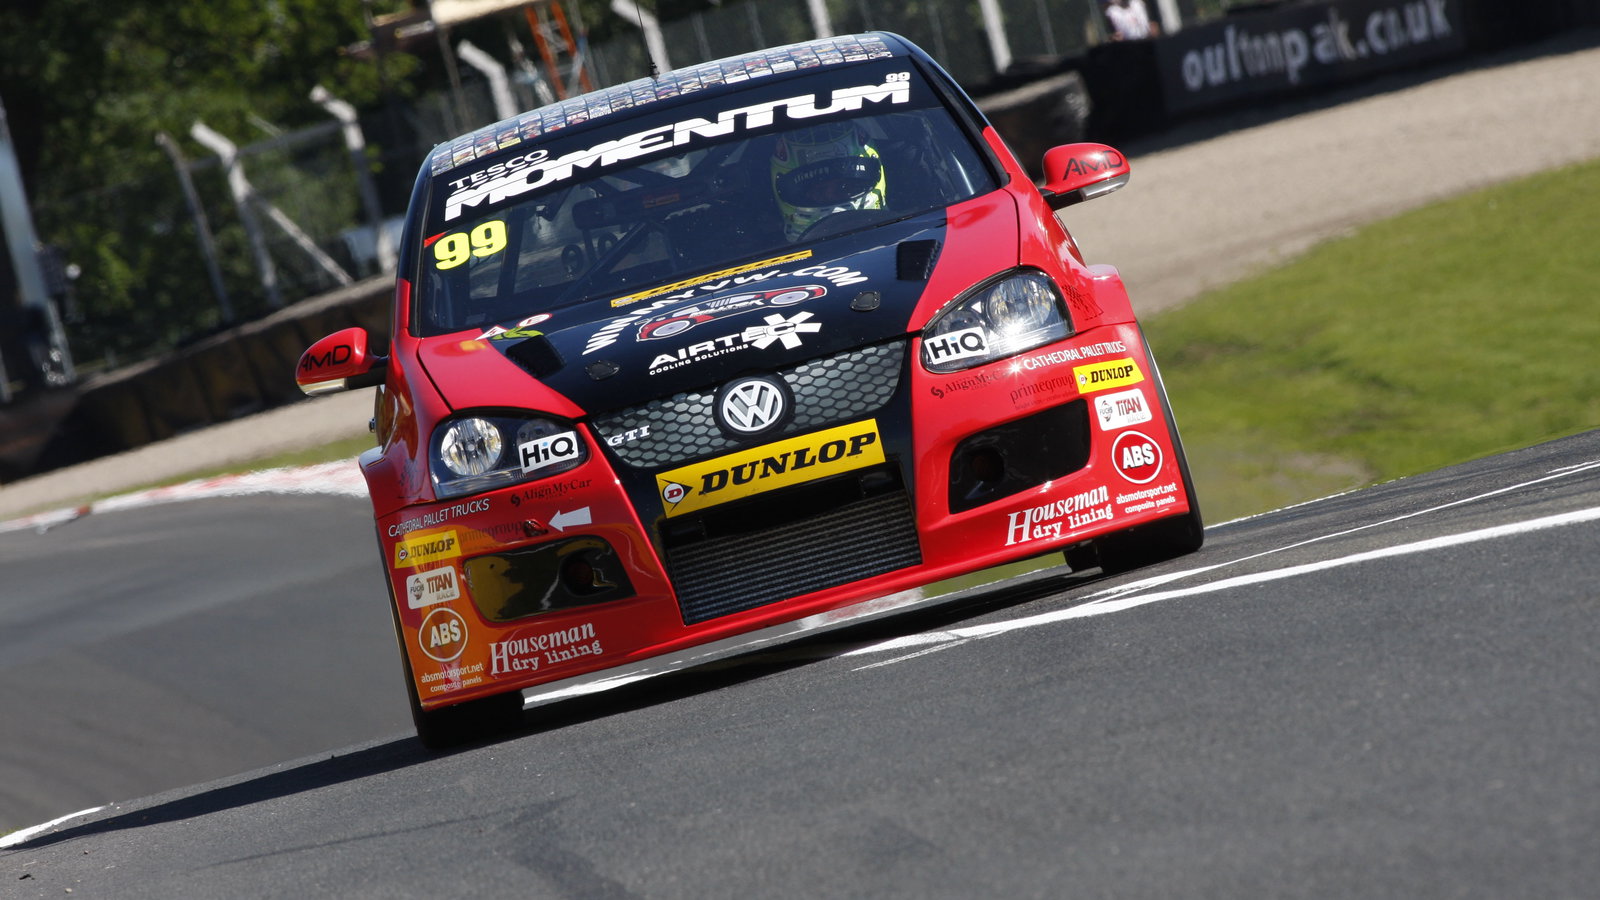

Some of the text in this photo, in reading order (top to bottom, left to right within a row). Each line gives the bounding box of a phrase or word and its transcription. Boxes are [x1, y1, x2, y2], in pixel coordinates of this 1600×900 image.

[886, 72, 910, 82] 99
[445, 81, 910, 221] MOMENTUM
[1063, 150, 1123, 181] AMD
[449, 150, 549, 189] TESCO
[434, 220, 507, 270] 99
[649, 322, 797, 370] AIRTEC
[650, 344, 749, 375] COOLING SOLUTIONS
[929, 332, 985, 359] HiQ
[1023, 348, 1083, 371] CATHEDRAL
[1081, 343, 1105, 358] PALLET
[1009, 373, 1074, 404] primegroup
[1090, 364, 1134, 384] DUNLOP
[607, 425, 650, 447] GTI
[522, 437, 575, 468] HiQ
[698, 432, 877, 495] DUNLOP
[1122, 443, 1155, 469] ABS
[521, 478, 592, 502] AlignMyCar
[1116, 482, 1177, 505] absmotorsport.net
[1125, 495, 1176, 514] composite panels
[388, 498, 490, 538] CATHEDRAL PALLET TRUCKS
[1005, 485, 1109, 546] Houseman
[1033, 504, 1114, 539] dry lining
[409, 537, 455, 558] DUNLOP
[430, 620, 461, 648] ABS
[489, 623, 595, 676] Houseman
[512, 640, 603, 671] dry lining
[421, 662, 484, 684] absmotorsport.net
[430, 675, 482, 693] composite panels
